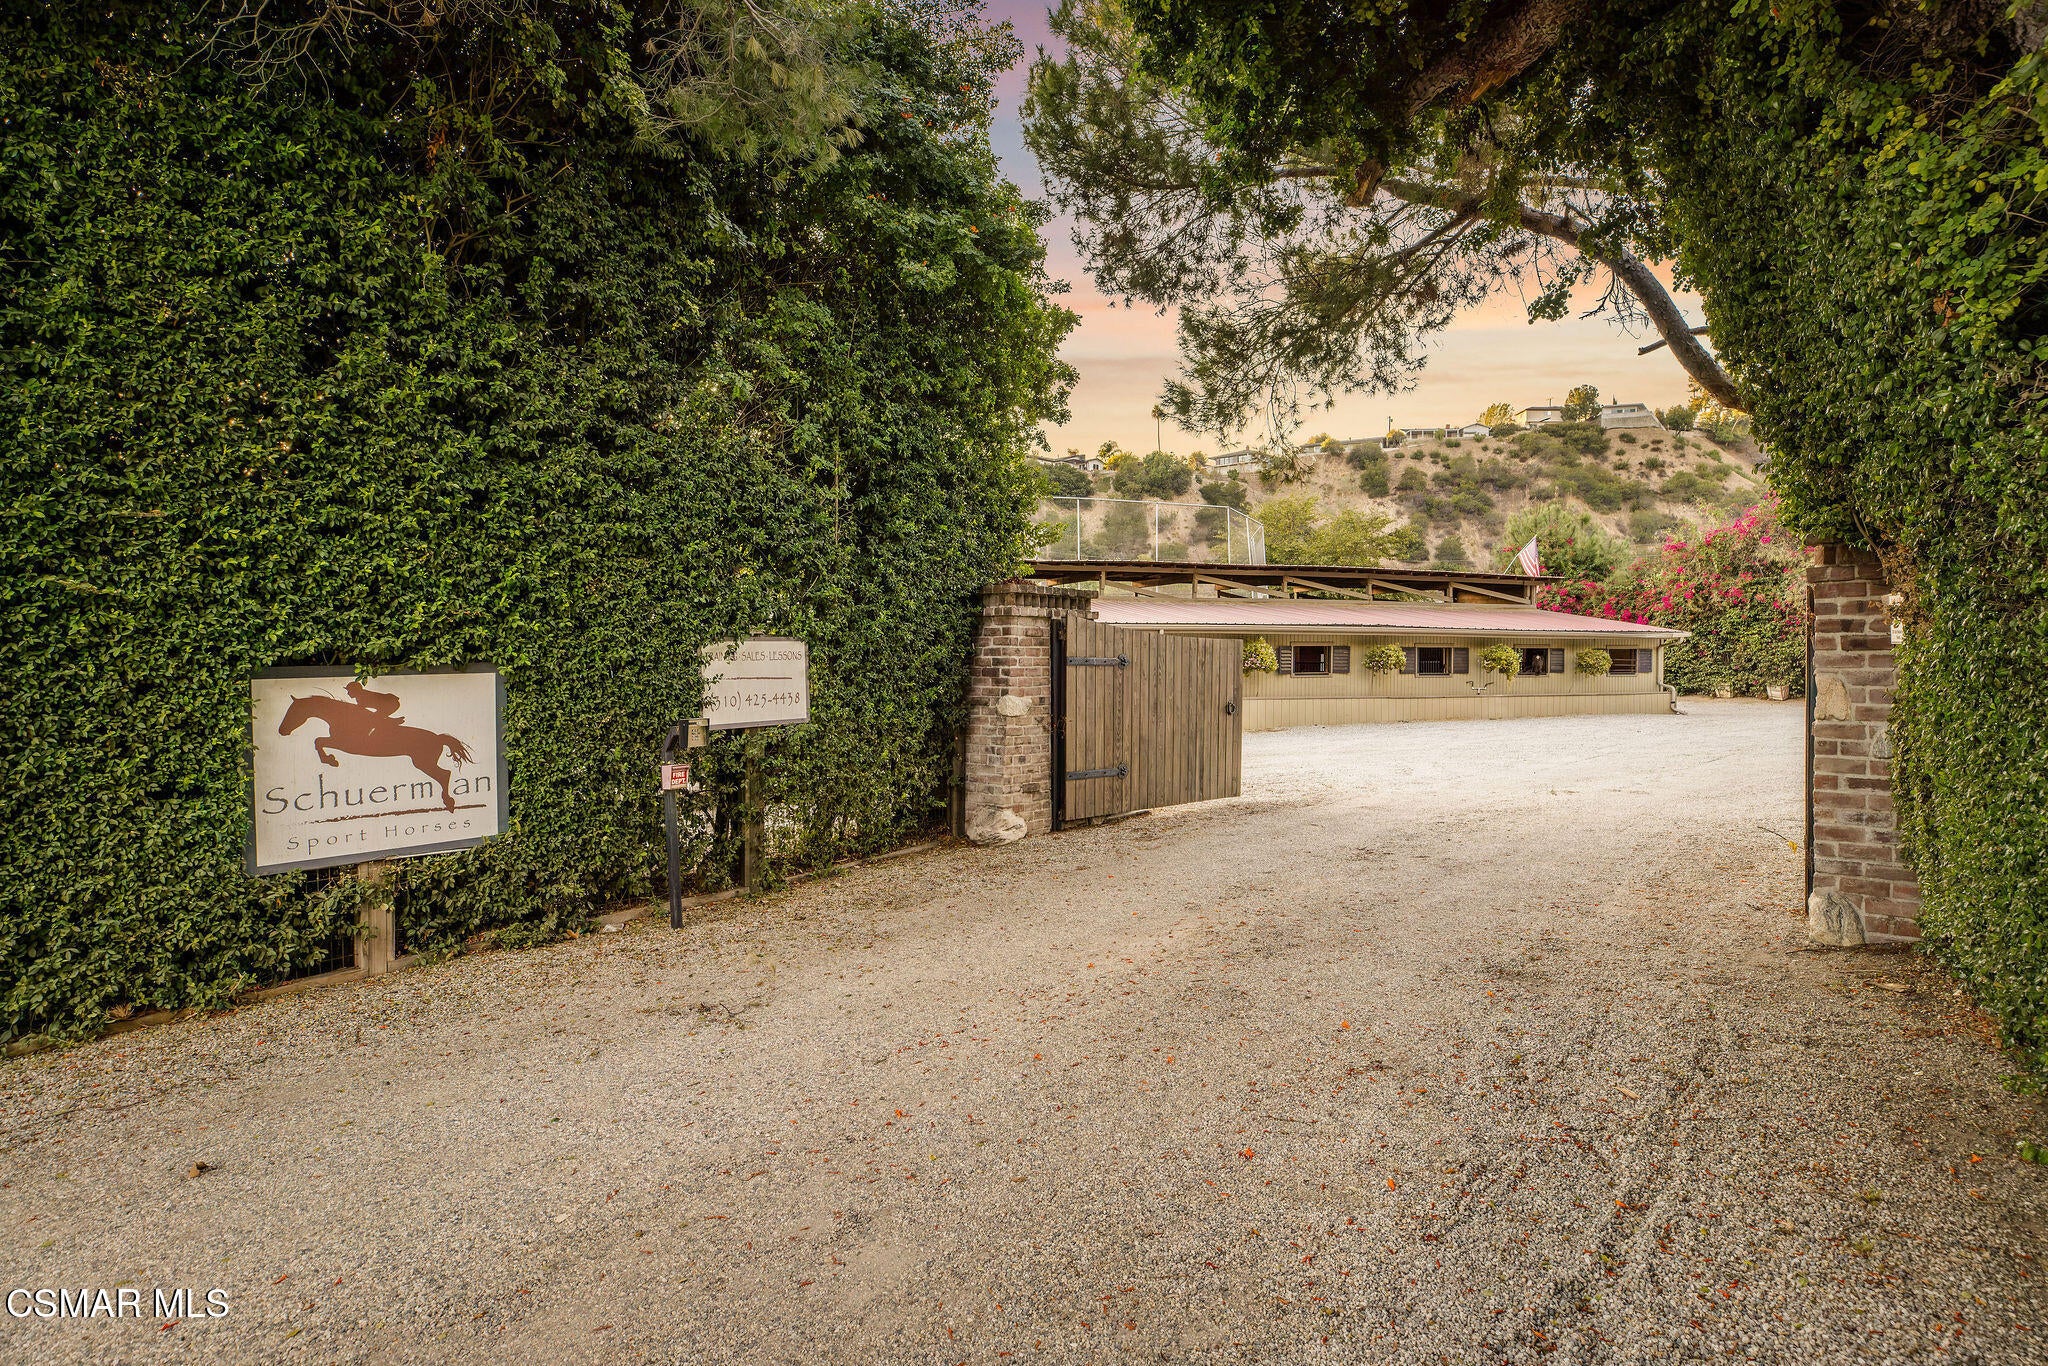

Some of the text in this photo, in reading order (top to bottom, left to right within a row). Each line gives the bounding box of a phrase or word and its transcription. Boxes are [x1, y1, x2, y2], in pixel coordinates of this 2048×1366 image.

[744, 692, 801, 708] 425-4438
[262, 773, 491, 815] Schuerman
[287, 819, 472, 855] Sport Horses
